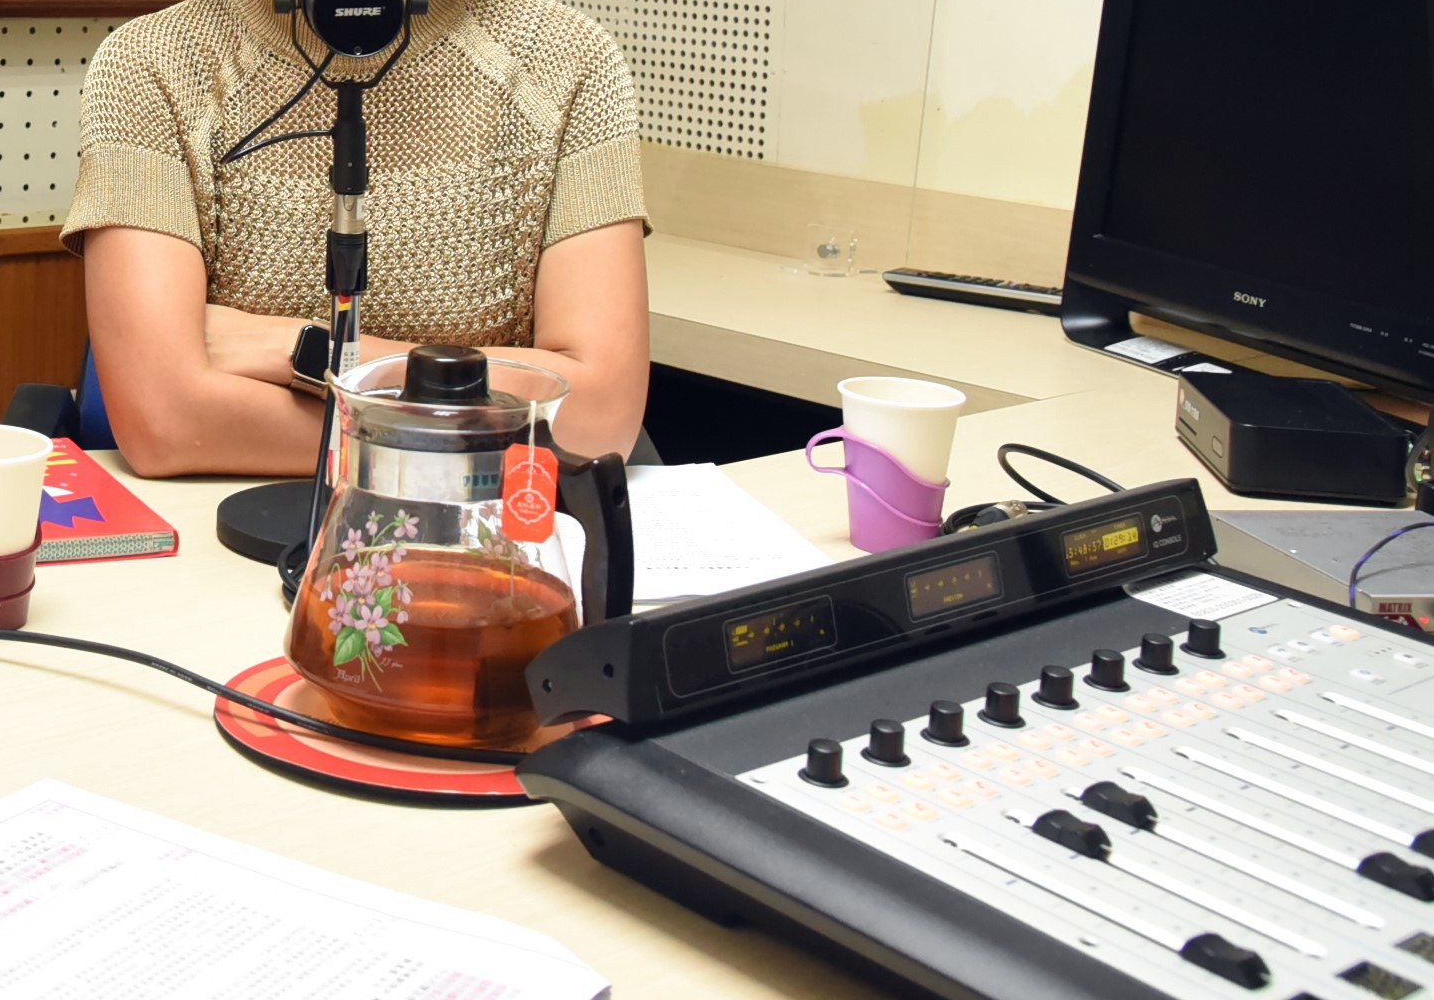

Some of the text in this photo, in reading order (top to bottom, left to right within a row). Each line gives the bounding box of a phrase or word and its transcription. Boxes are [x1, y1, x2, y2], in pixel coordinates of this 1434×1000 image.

[334, 6, 382, 18] SHURE
[1233, 291, 1267, 308] SONY
[1378, 602, 1413, 613] MATRIX
[333, 667, 362, 684] April
